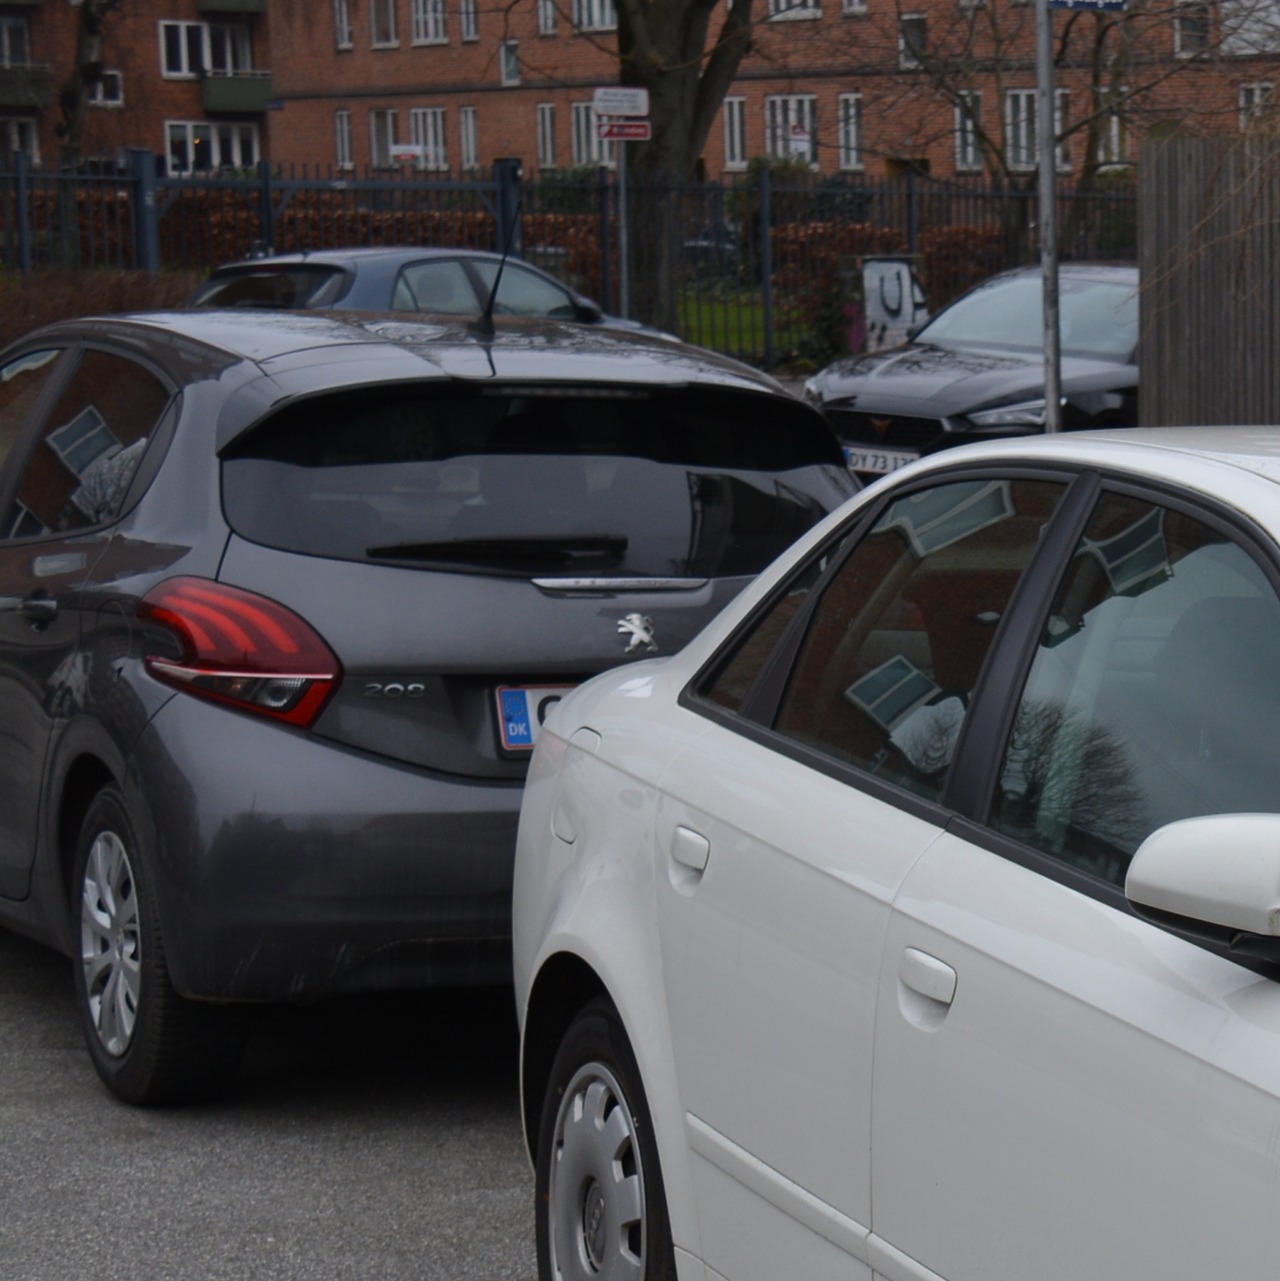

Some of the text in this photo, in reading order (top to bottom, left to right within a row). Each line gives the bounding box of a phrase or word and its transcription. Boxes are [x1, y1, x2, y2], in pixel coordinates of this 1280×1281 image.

[872, 454, 888, 471] 73
[363, 683, 425, 698] 208
[508, 723, 527, 736] DK
